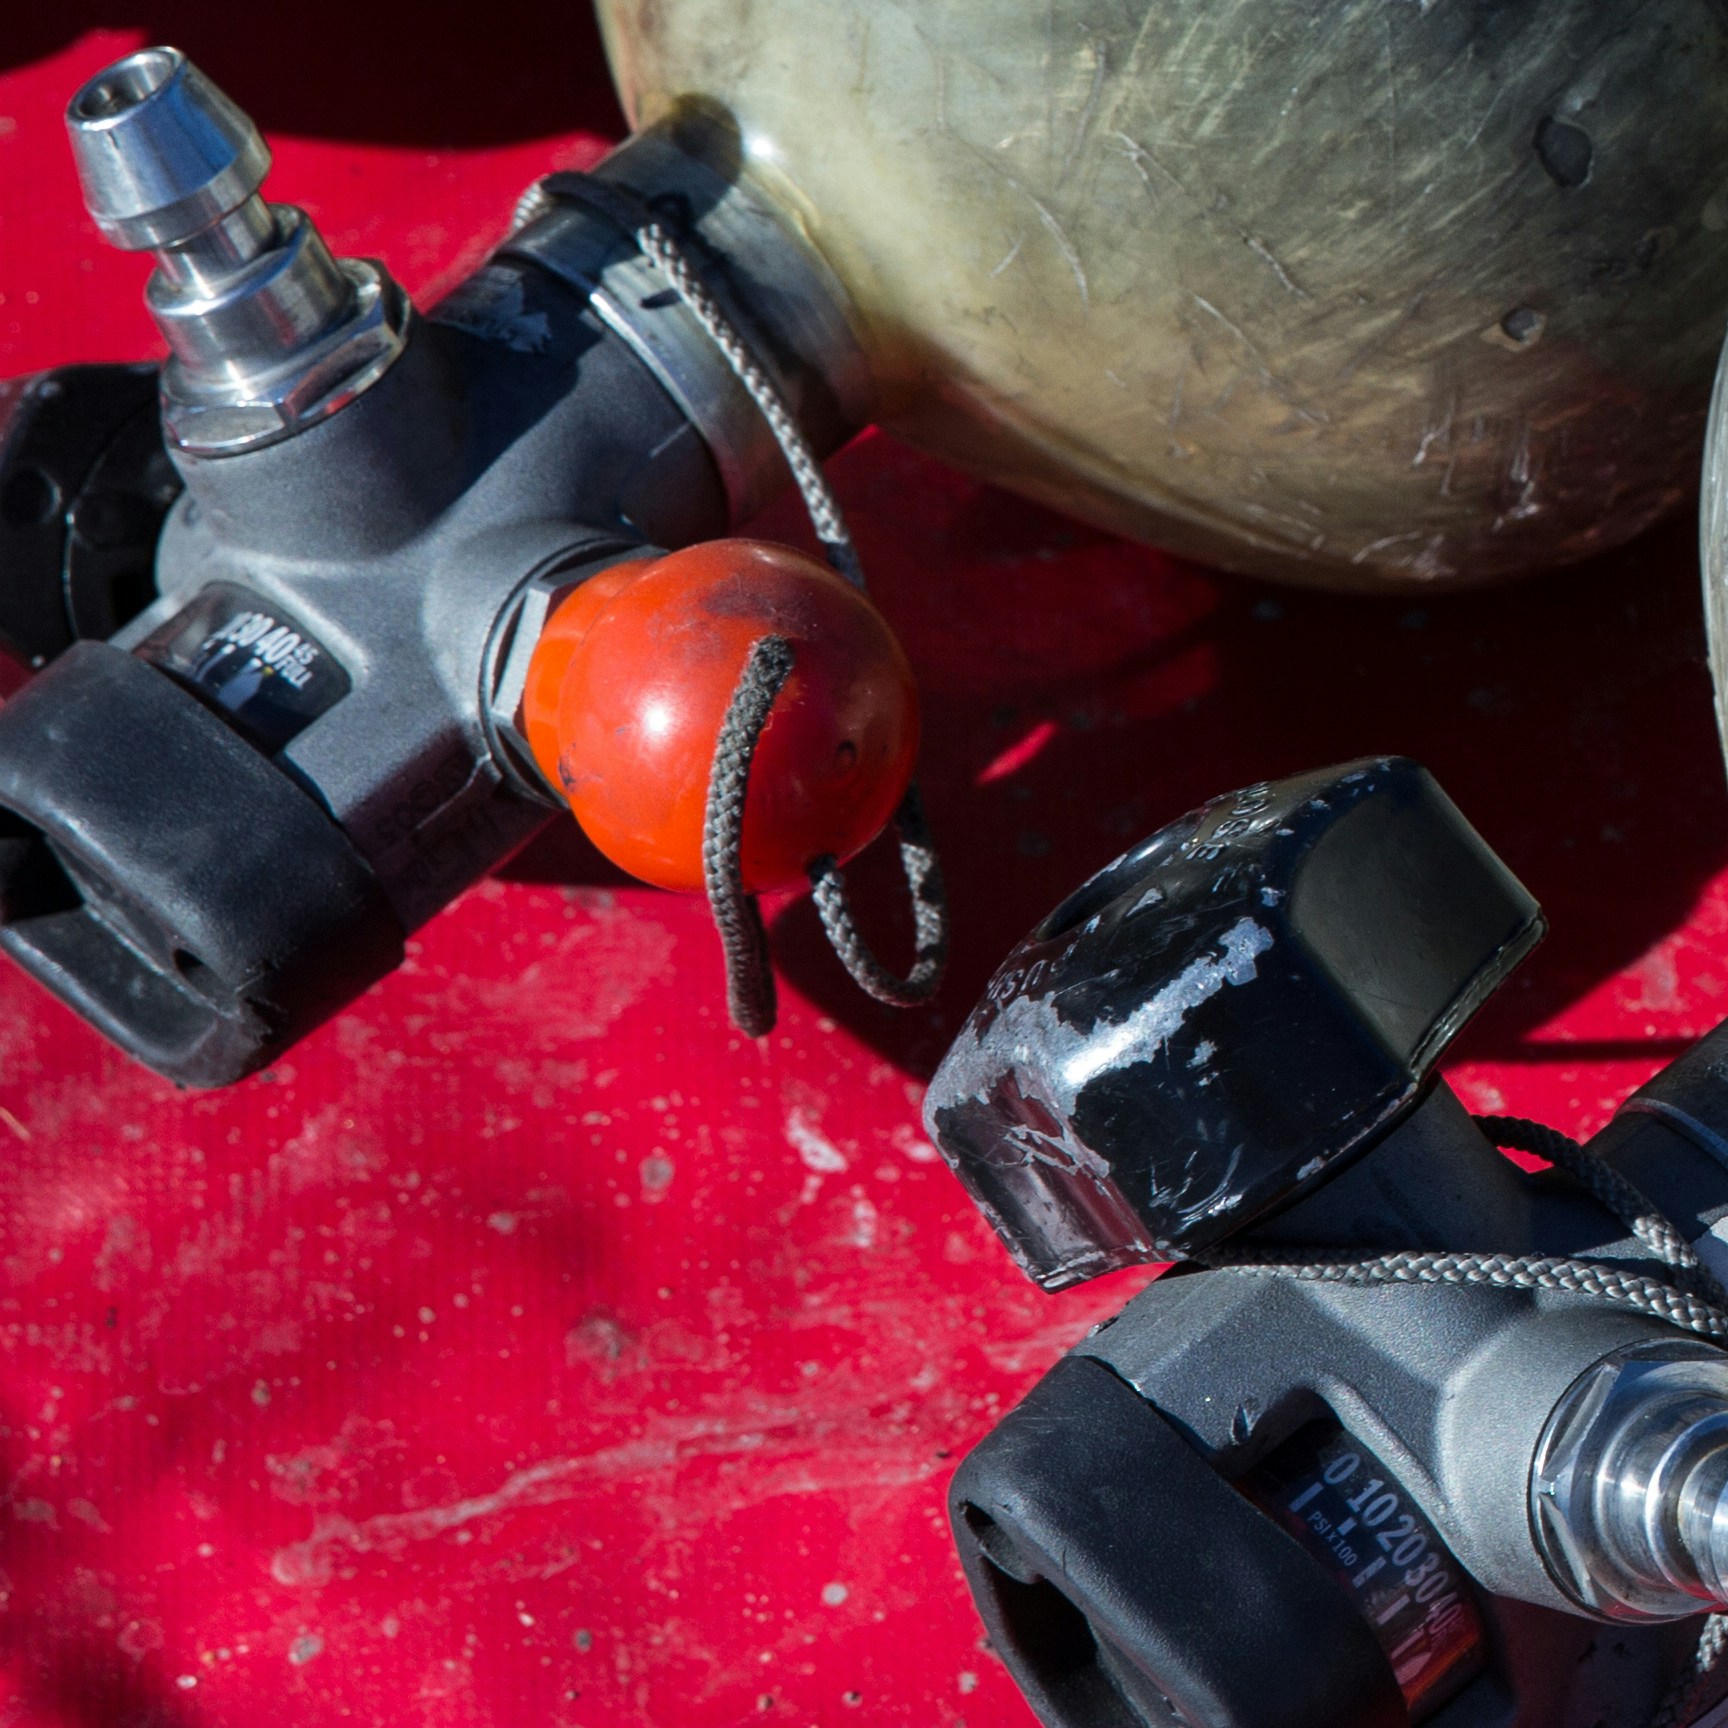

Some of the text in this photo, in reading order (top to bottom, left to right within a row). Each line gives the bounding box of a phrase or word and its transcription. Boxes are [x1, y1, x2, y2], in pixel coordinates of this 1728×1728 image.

[254, 626, 301, 665] 40
[293, 643, 320, 665] 45
[273, 654, 313, 689] FULL
[1307, 1511, 1329, 1535] PSI
[1333, 1539, 1359, 1567] 100
[1323, 1452, 1362, 1486] 0
[1347, 1478, 1399, 1529] 10
[1377, 1513, 1428, 1567] 20
[1404, 1552, 1450, 1603] 30
